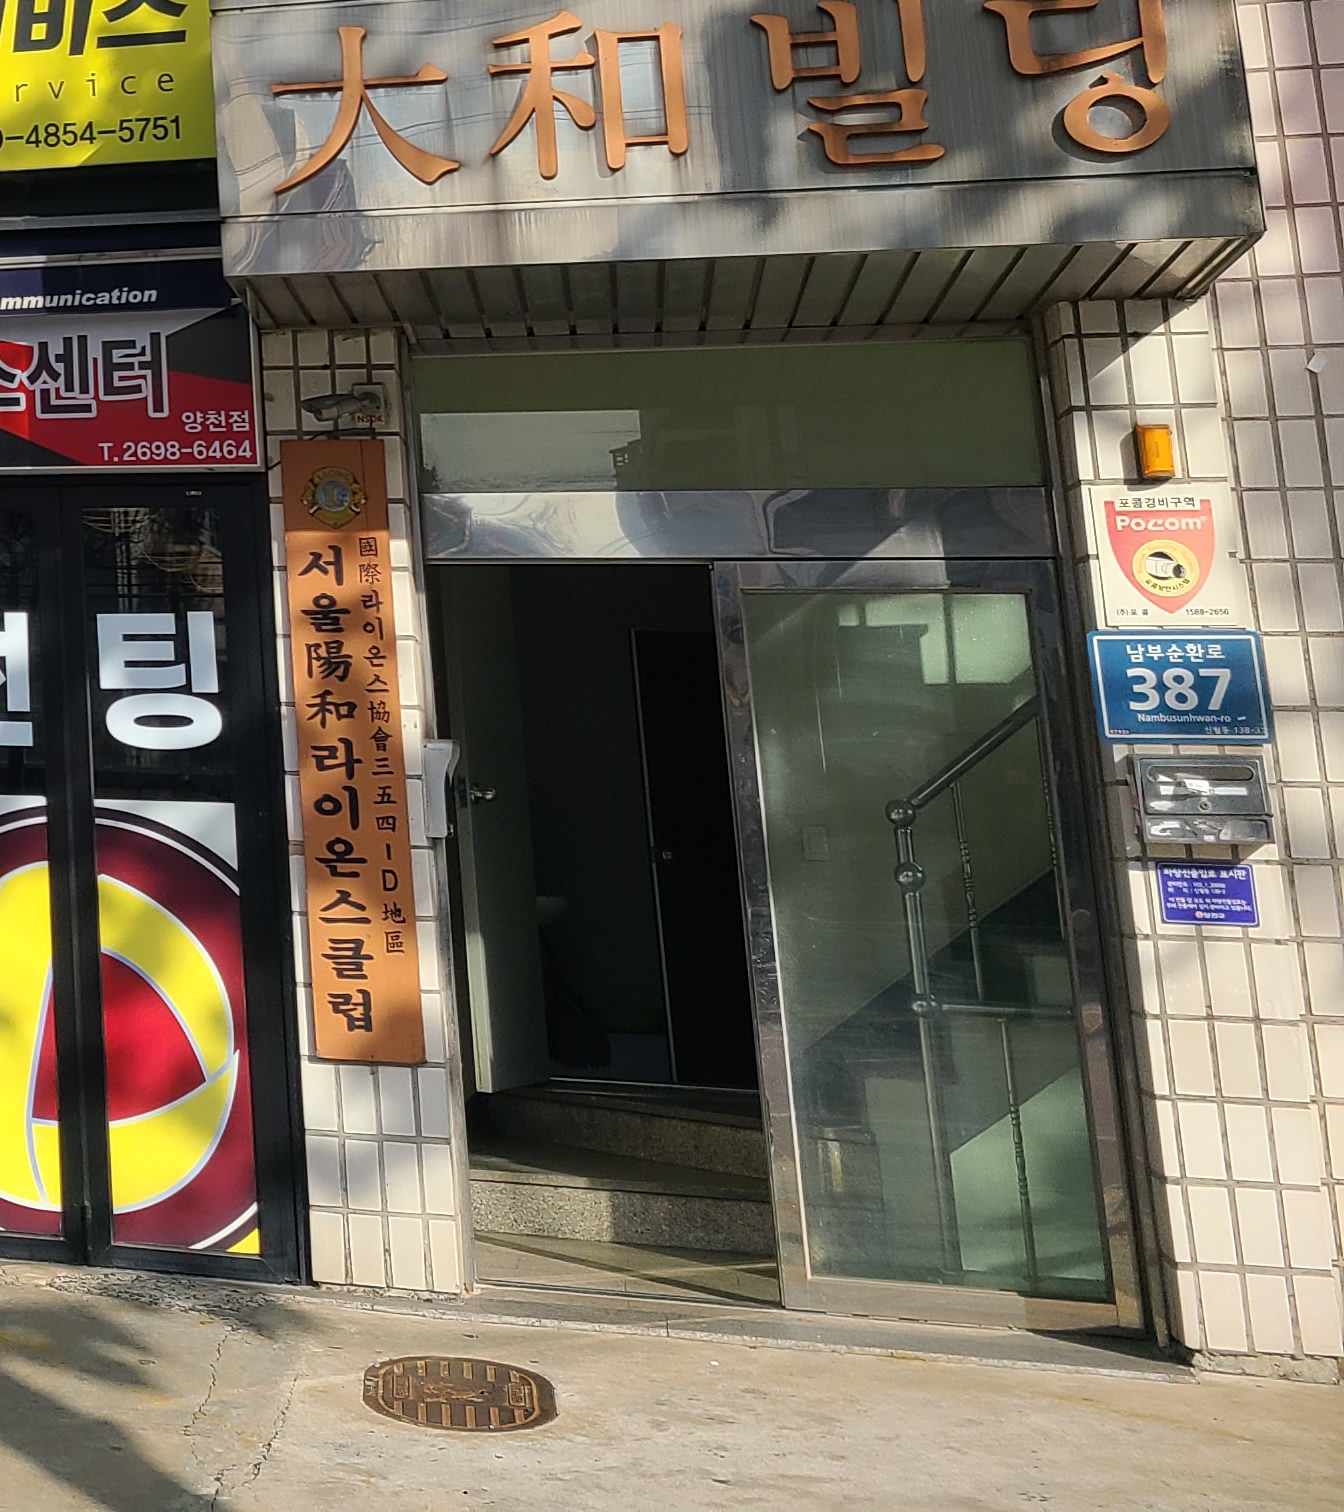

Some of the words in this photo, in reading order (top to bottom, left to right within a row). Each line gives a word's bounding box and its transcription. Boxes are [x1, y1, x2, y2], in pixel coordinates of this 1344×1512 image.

[181, 410, 251, 434] 양천점
[1126, 643, 1226, 663] 남부순환로
[1126, 668, 1231, 710] 387
[1138, 713, 1231, 723] Nambusunhwan-ro
